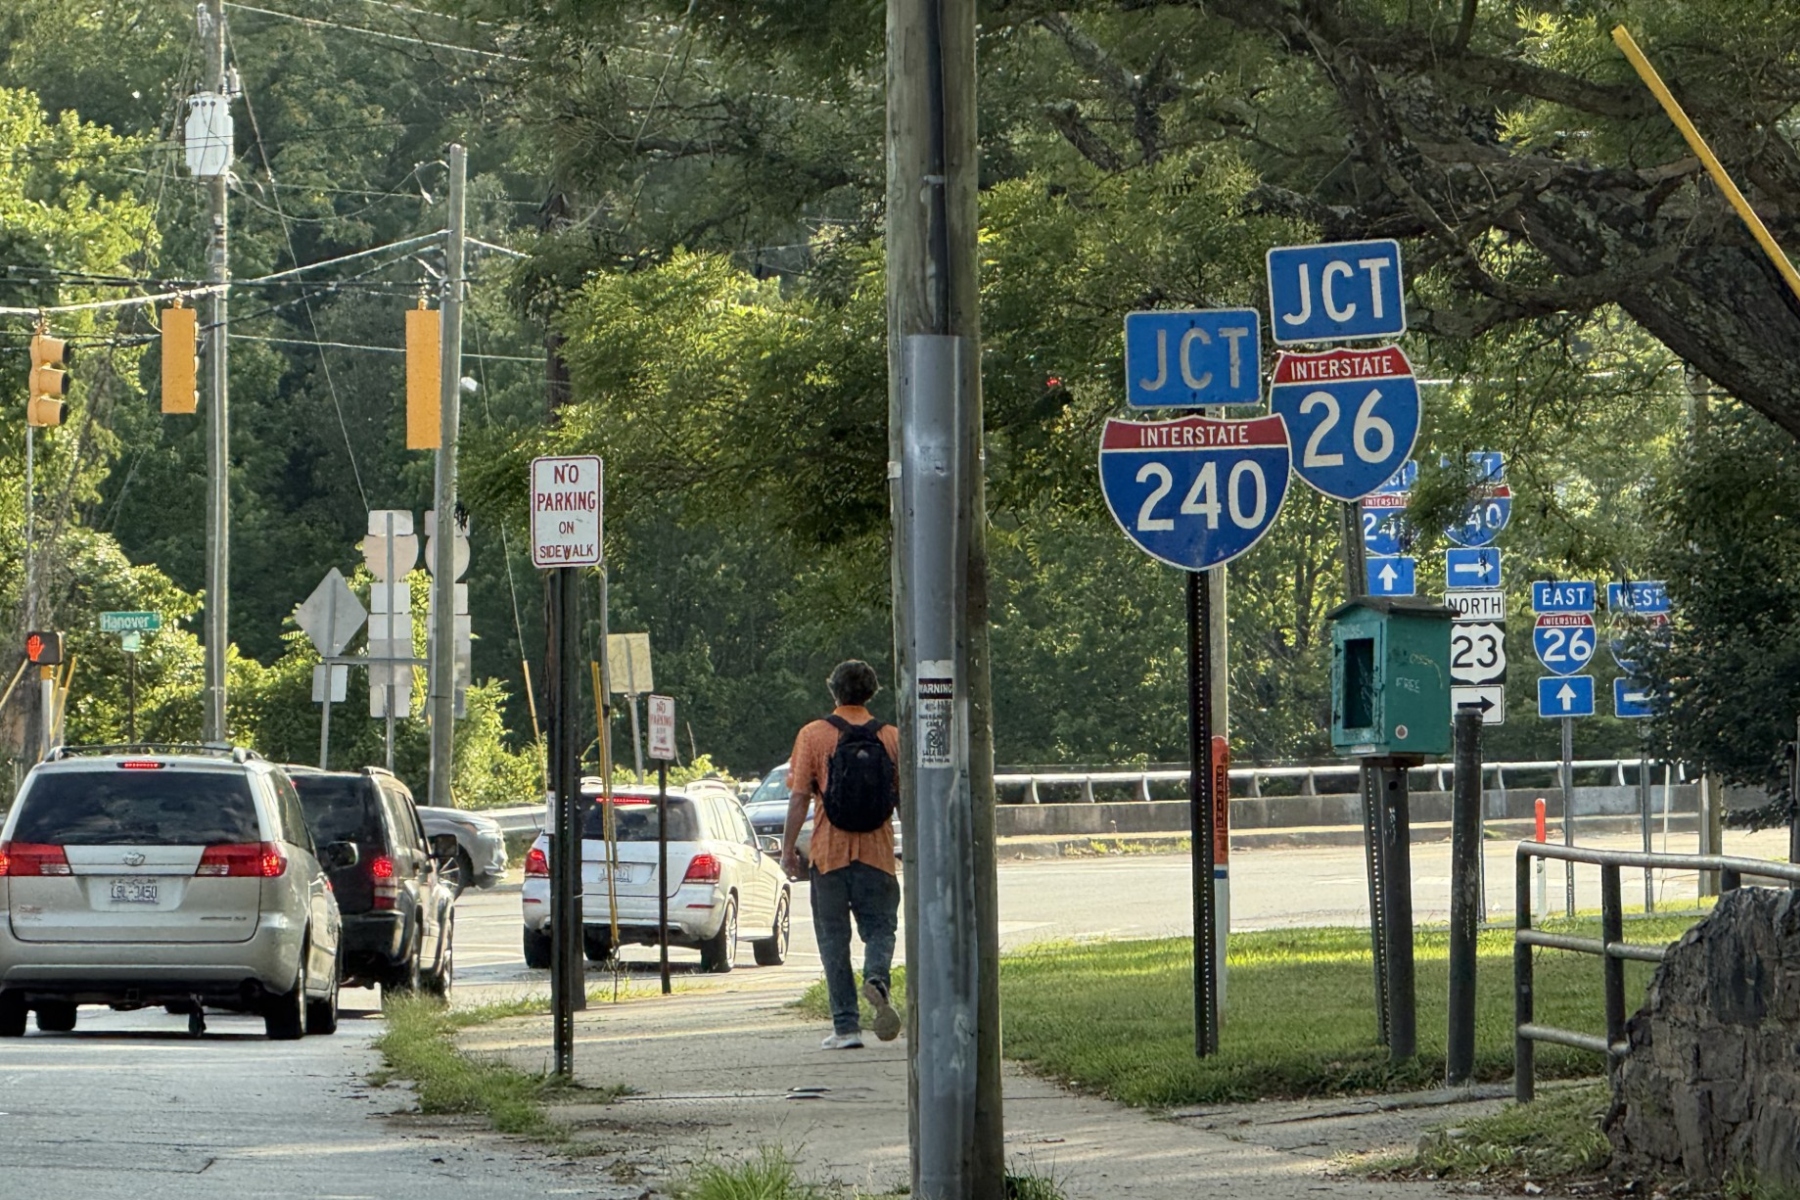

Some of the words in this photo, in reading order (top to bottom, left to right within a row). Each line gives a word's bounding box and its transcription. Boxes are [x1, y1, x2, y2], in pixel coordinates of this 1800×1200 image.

[1282, 257, 1390, 325] JCT
[1139, 327, 1249, 391] JCT
[1291, 356, 1393, 380] INTERSTATE
[1140, 425, 1249, 446] INTERSTATE
[1299, 389, 1394, 468] 26
[554, 465, 579, 484] NO
[537, 491, 596, 511] PARKING
[1135, 459, 1267, 532] 240
[559, 521, 574, 535] ON
[540, 544, 593, 559] SIDEWALK
[1447, 597, 1501, 615] NORTH
[1542, 587, 1586, 605] EAST
[102, 615, 149, 629] Hanover
[1543, 616, 1587, 626] INTERSTATE
[1452, 634, 1498, 668] 23
[1543, 628, 1591, 661] 26
